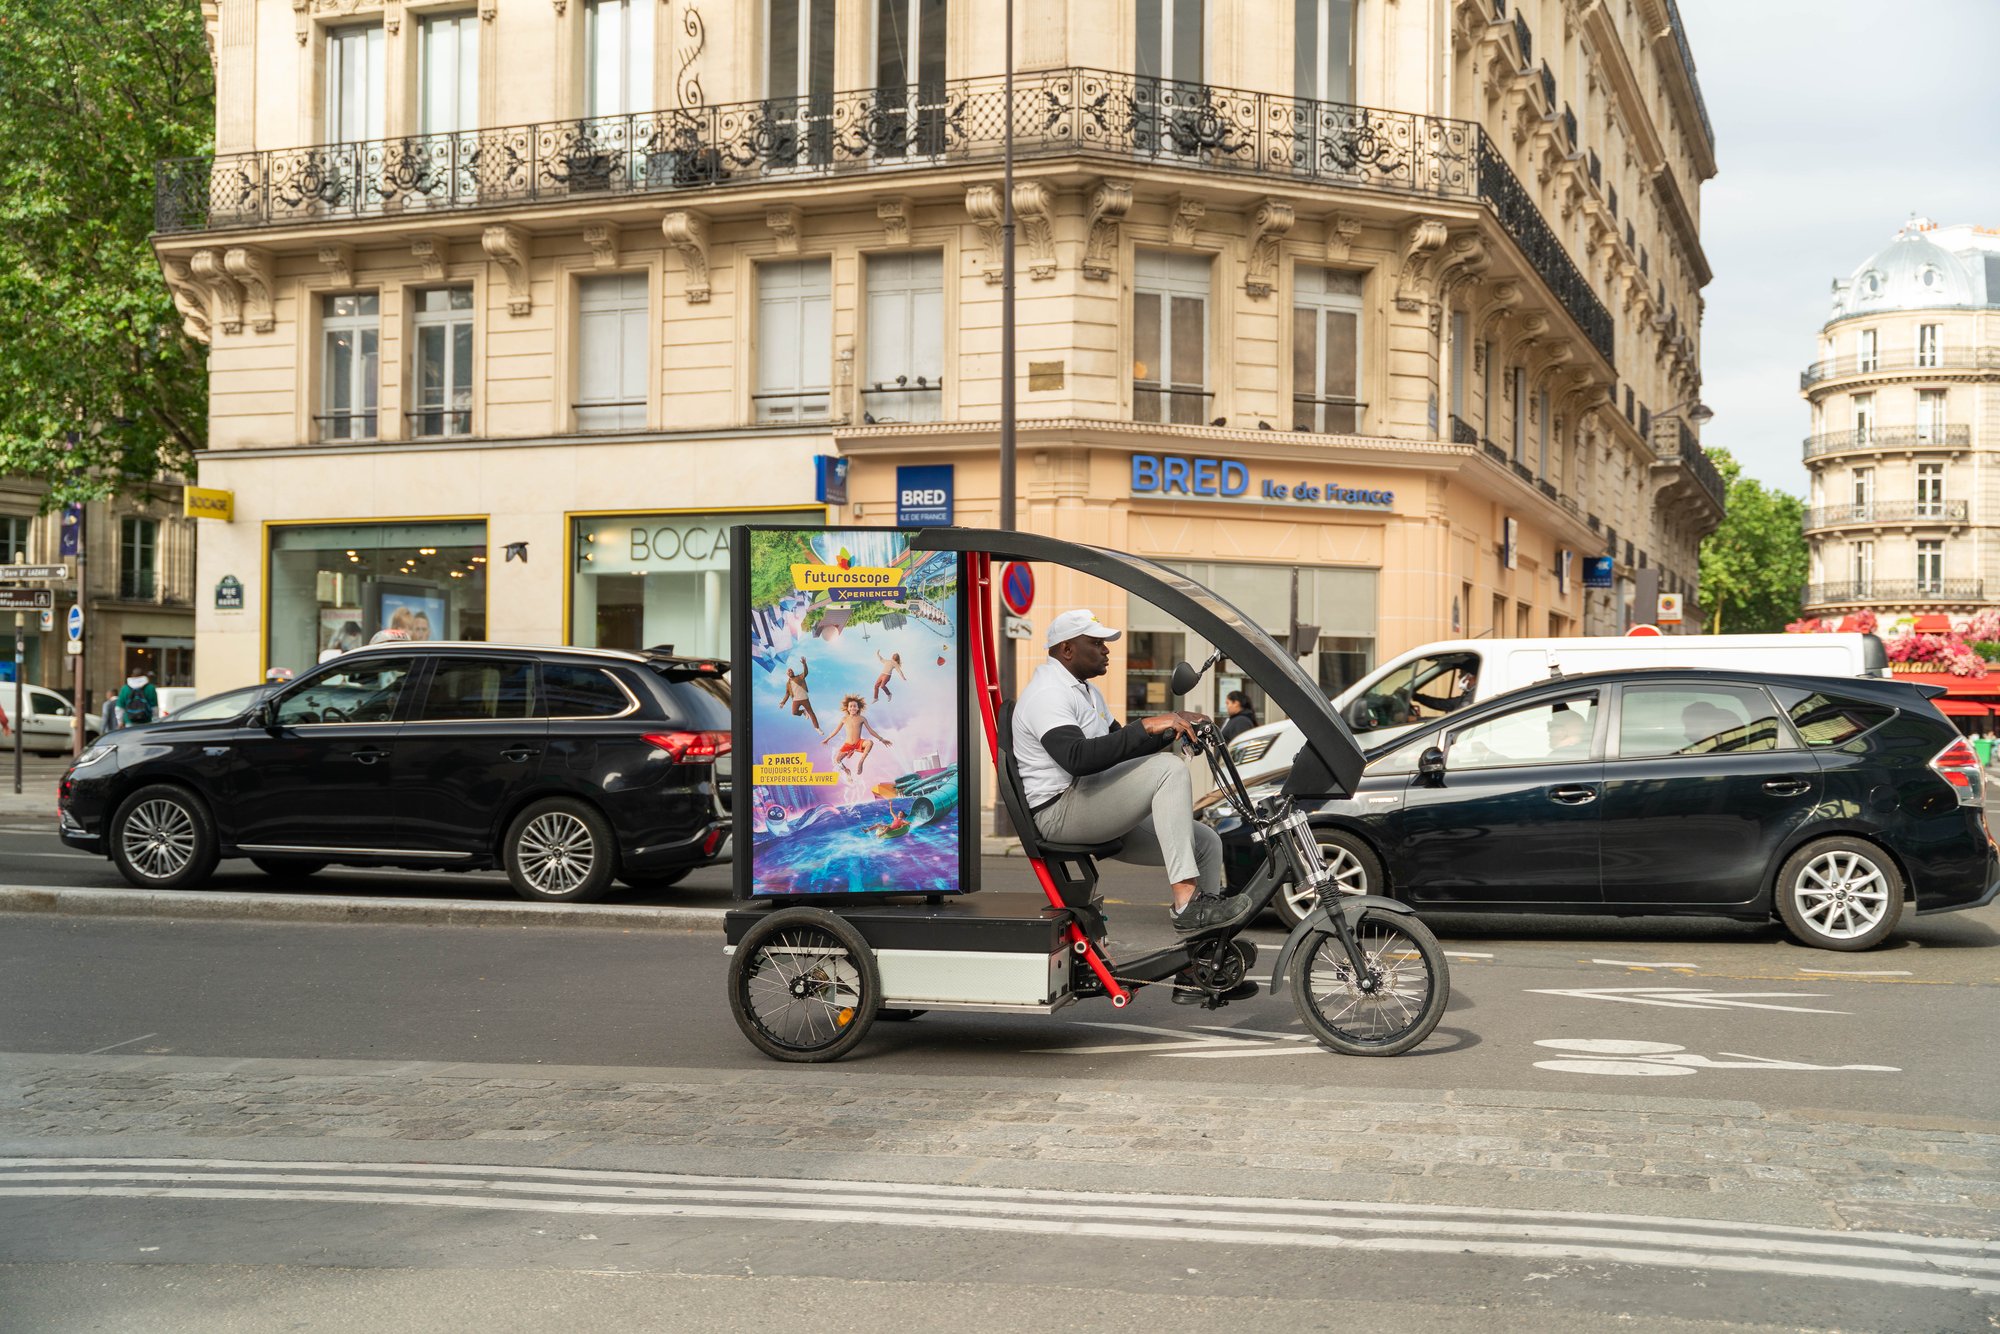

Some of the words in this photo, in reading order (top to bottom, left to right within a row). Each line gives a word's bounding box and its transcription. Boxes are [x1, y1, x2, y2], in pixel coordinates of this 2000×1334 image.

[1132, 454, 1249, 496] BRED
[1263, 480, 1288, 498] Ile
[1293, 481, 1320, 500] de
[1326, 483, 1394, 504] France
[901, 490, 946, 505] BRED
[900, 513, 910, 521] ILE
[910, 513, 920, 521] DE
[920, 512, 947, 520] FRANCE
[630, 527, 730, 561] BOCA
[28, 568, 49, 577] LAZARE
[805, 570, 890, 586] futuroscope
[838, 590, 900, 600] XPERIENCES
[775, 756, 803, 765] PARCS,
[760, 767, 791, 775] TOUJOURS
[793, 766, 809, 774] PLUS
